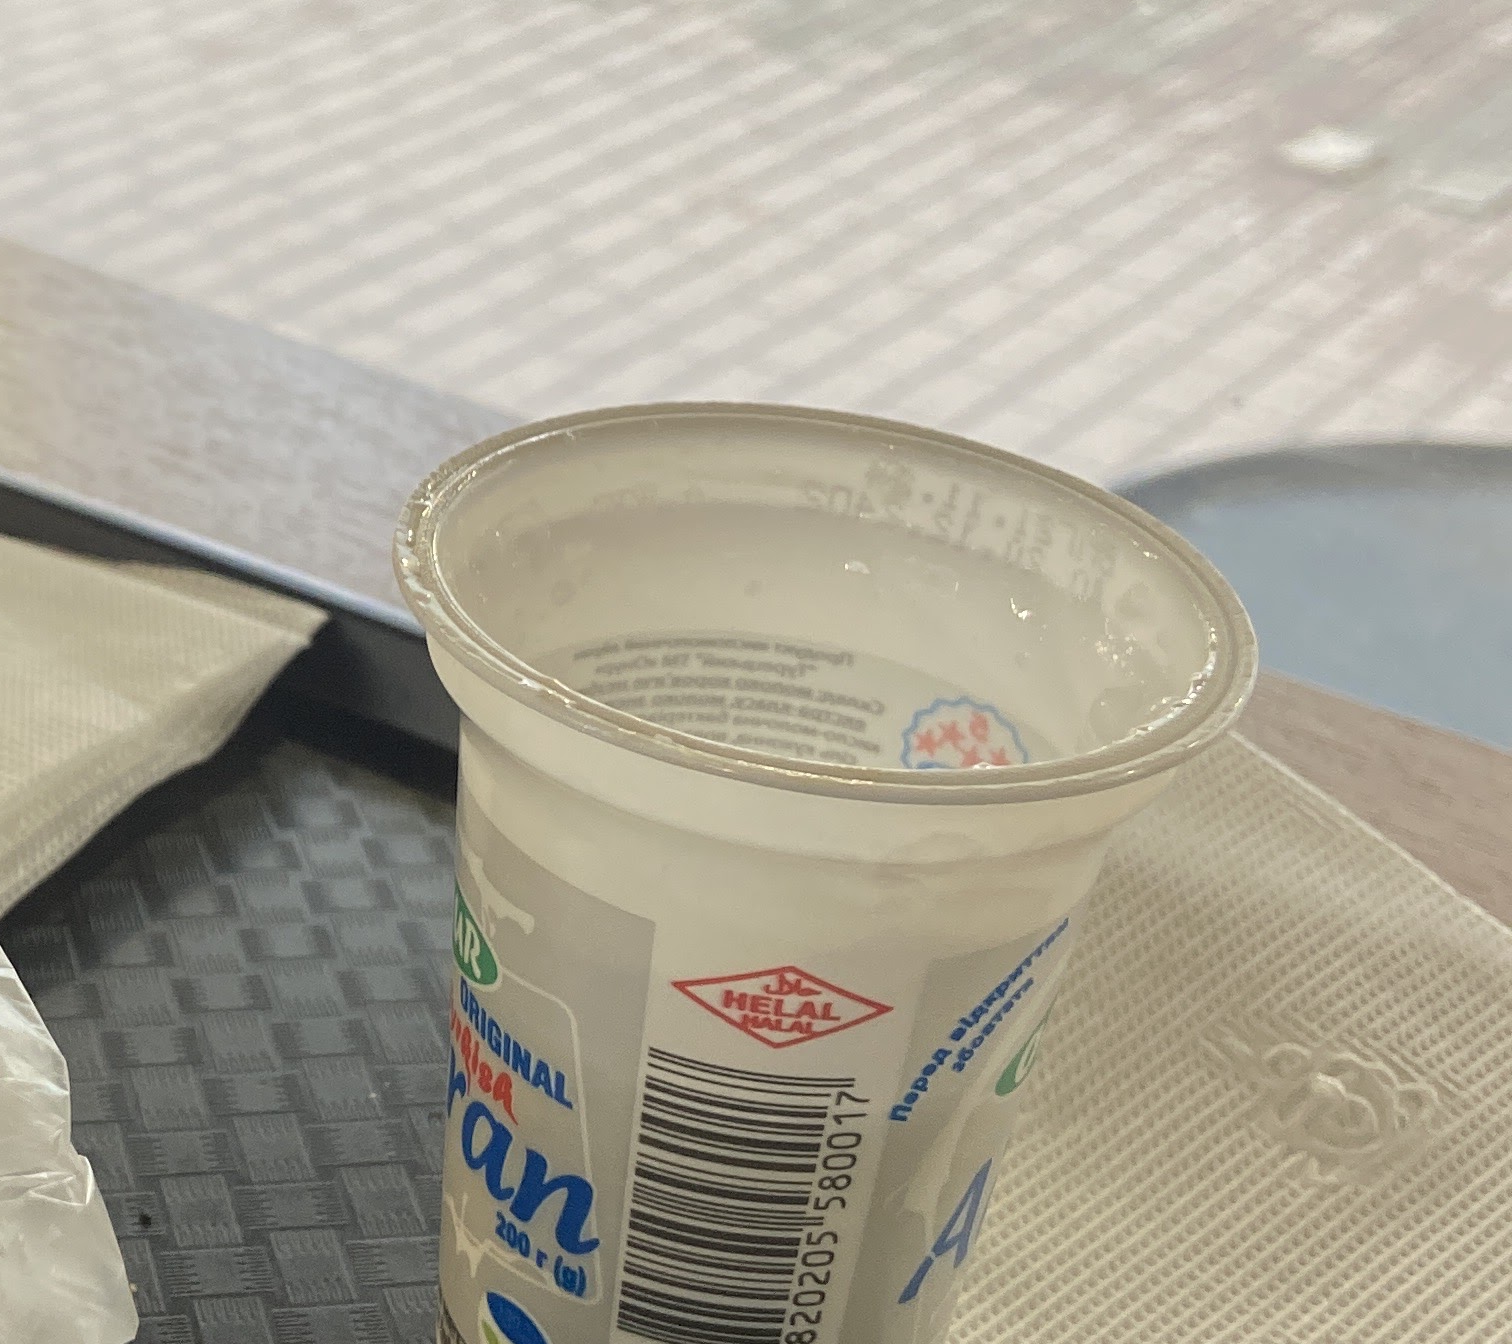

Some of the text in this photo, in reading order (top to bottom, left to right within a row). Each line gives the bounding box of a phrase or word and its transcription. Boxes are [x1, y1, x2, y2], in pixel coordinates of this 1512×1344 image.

[721, 988, 841, 1021] HELAL
[460, 974, 573, 1109] ORIGINAL
[494, 1210, 531, 1258] 200
